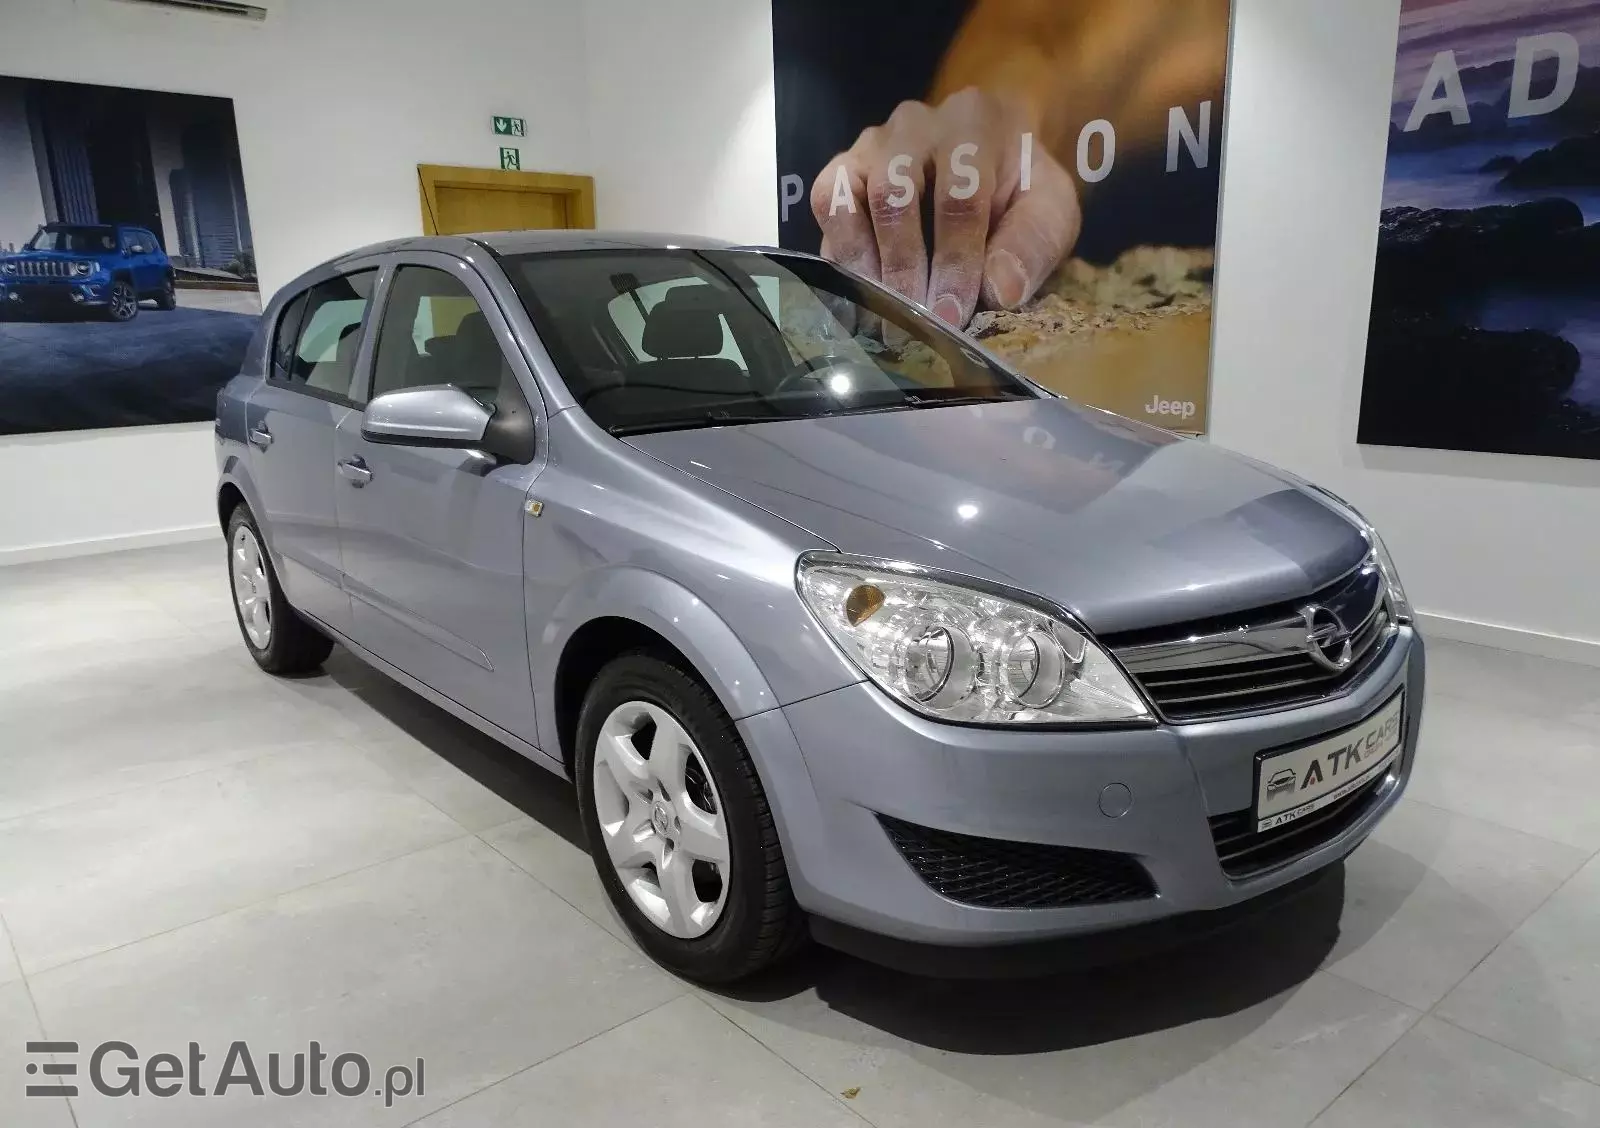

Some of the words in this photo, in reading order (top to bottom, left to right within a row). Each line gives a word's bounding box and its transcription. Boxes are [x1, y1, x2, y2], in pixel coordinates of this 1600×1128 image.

[1403, 31, 1580, 133] AD
[780, 101, 1211, 222] PASSION
[1145, 394, 1195, 419] Jeep
[1300, 737, 1362, 790] ATK
[1275, 810, 1296, 825] ATK
